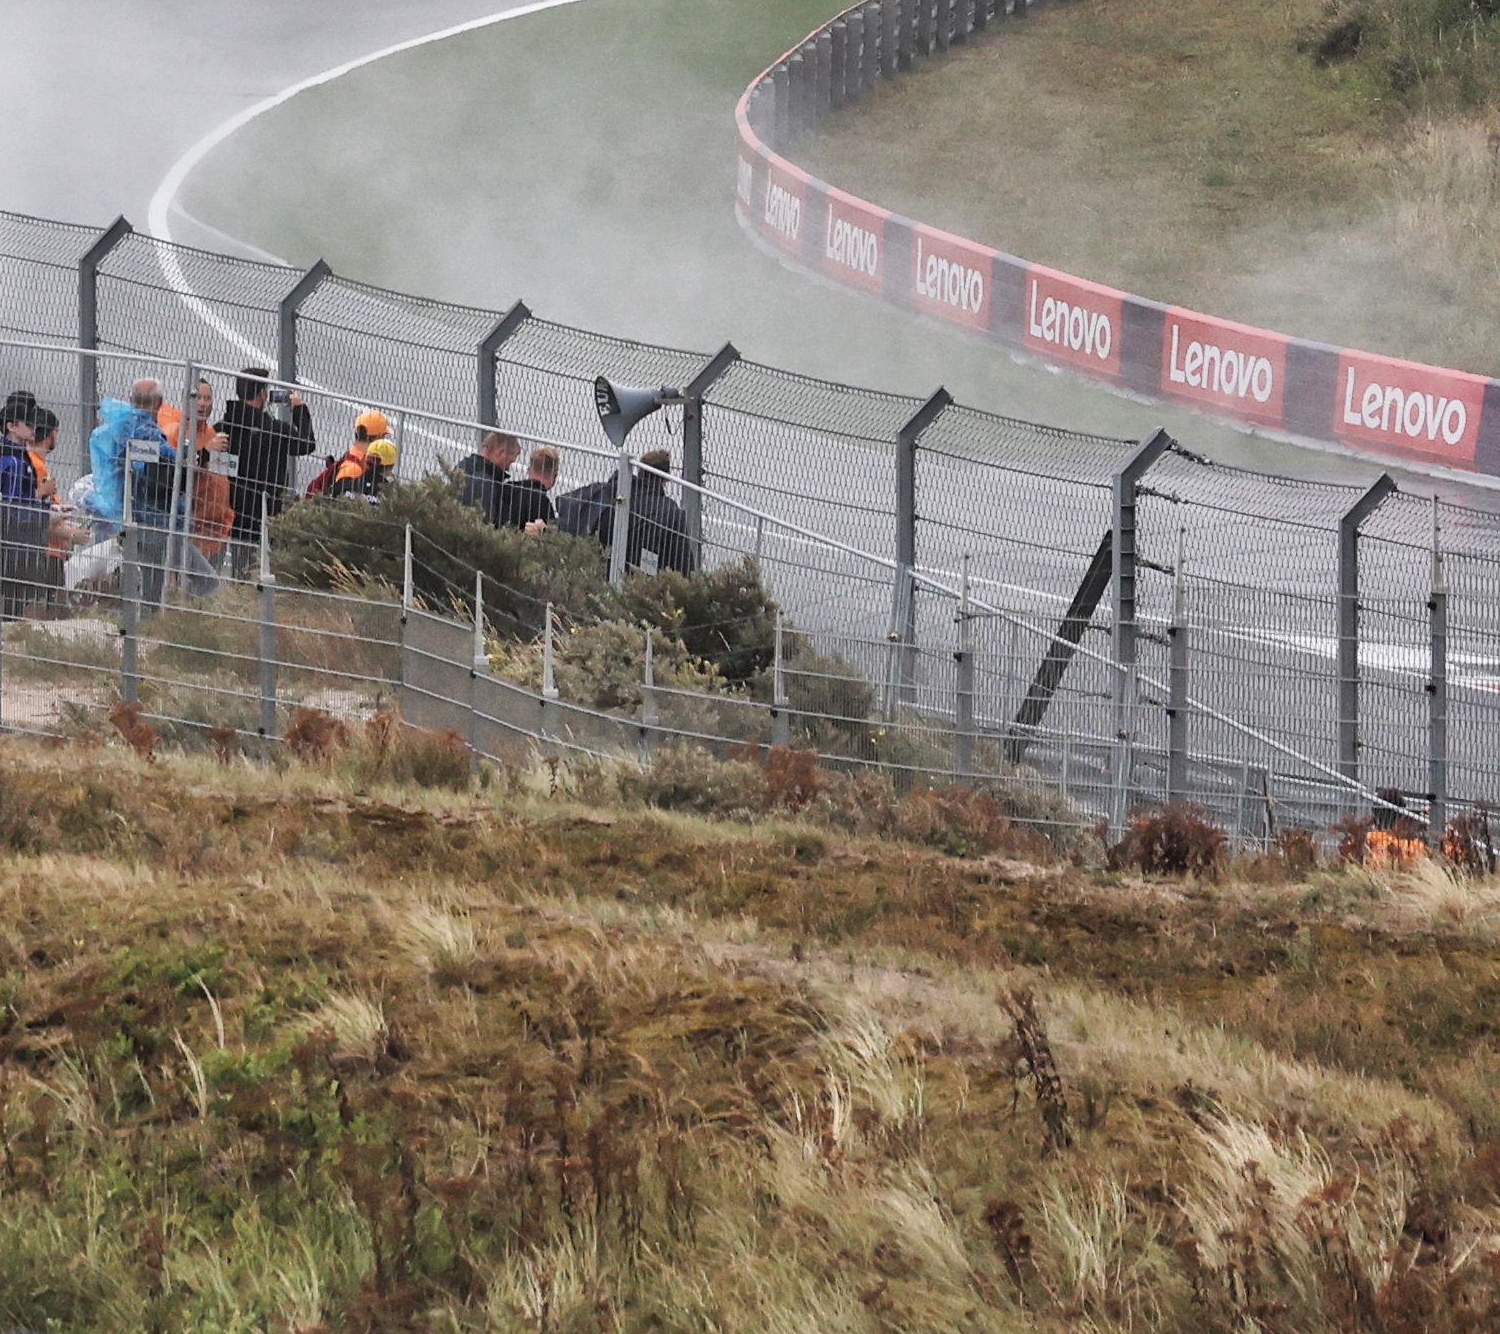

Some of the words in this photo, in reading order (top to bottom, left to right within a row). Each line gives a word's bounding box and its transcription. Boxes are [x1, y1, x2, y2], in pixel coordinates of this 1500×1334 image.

[764, 168, 801, 241] Lenovo
[826, 202, 878, 277] Lenovo
[915, 237, 984, 314] Lenovo
[1029, 279, 1113, 360] Lenovo
[1169, 324, 1274, 403] Lenovo
[1343, 366, 1468, 445] Lenovo
